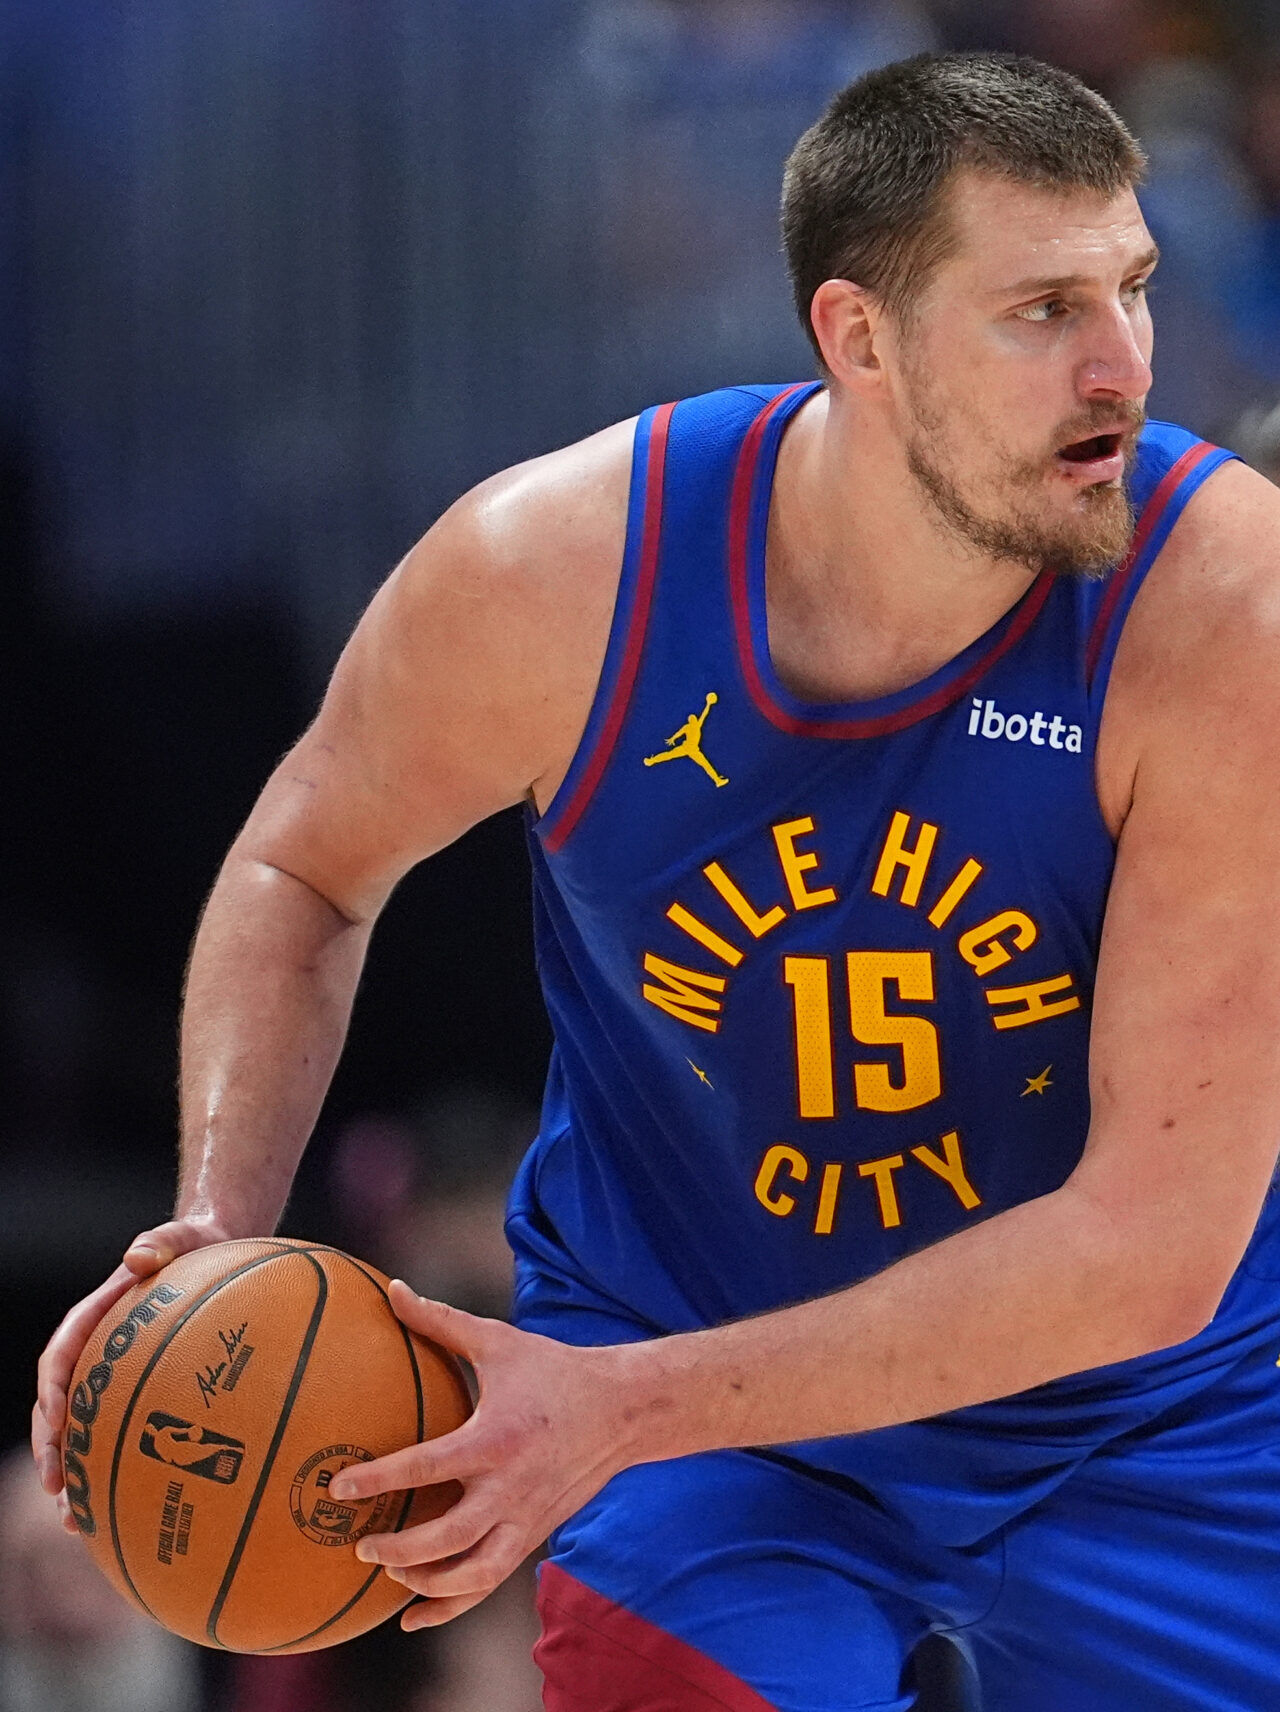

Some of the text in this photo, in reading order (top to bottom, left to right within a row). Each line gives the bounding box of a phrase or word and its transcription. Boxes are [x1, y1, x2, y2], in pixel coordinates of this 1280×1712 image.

[967, 696, 1084, 755] ibotta
[642, 810, 1082, 1034] MILE HIGH
[783, 950, 943, 1119] 15
[753, 1129, 983, 1236] CITY
[157, 1480, 184, 1566] OFFICIAL GAME BALL
